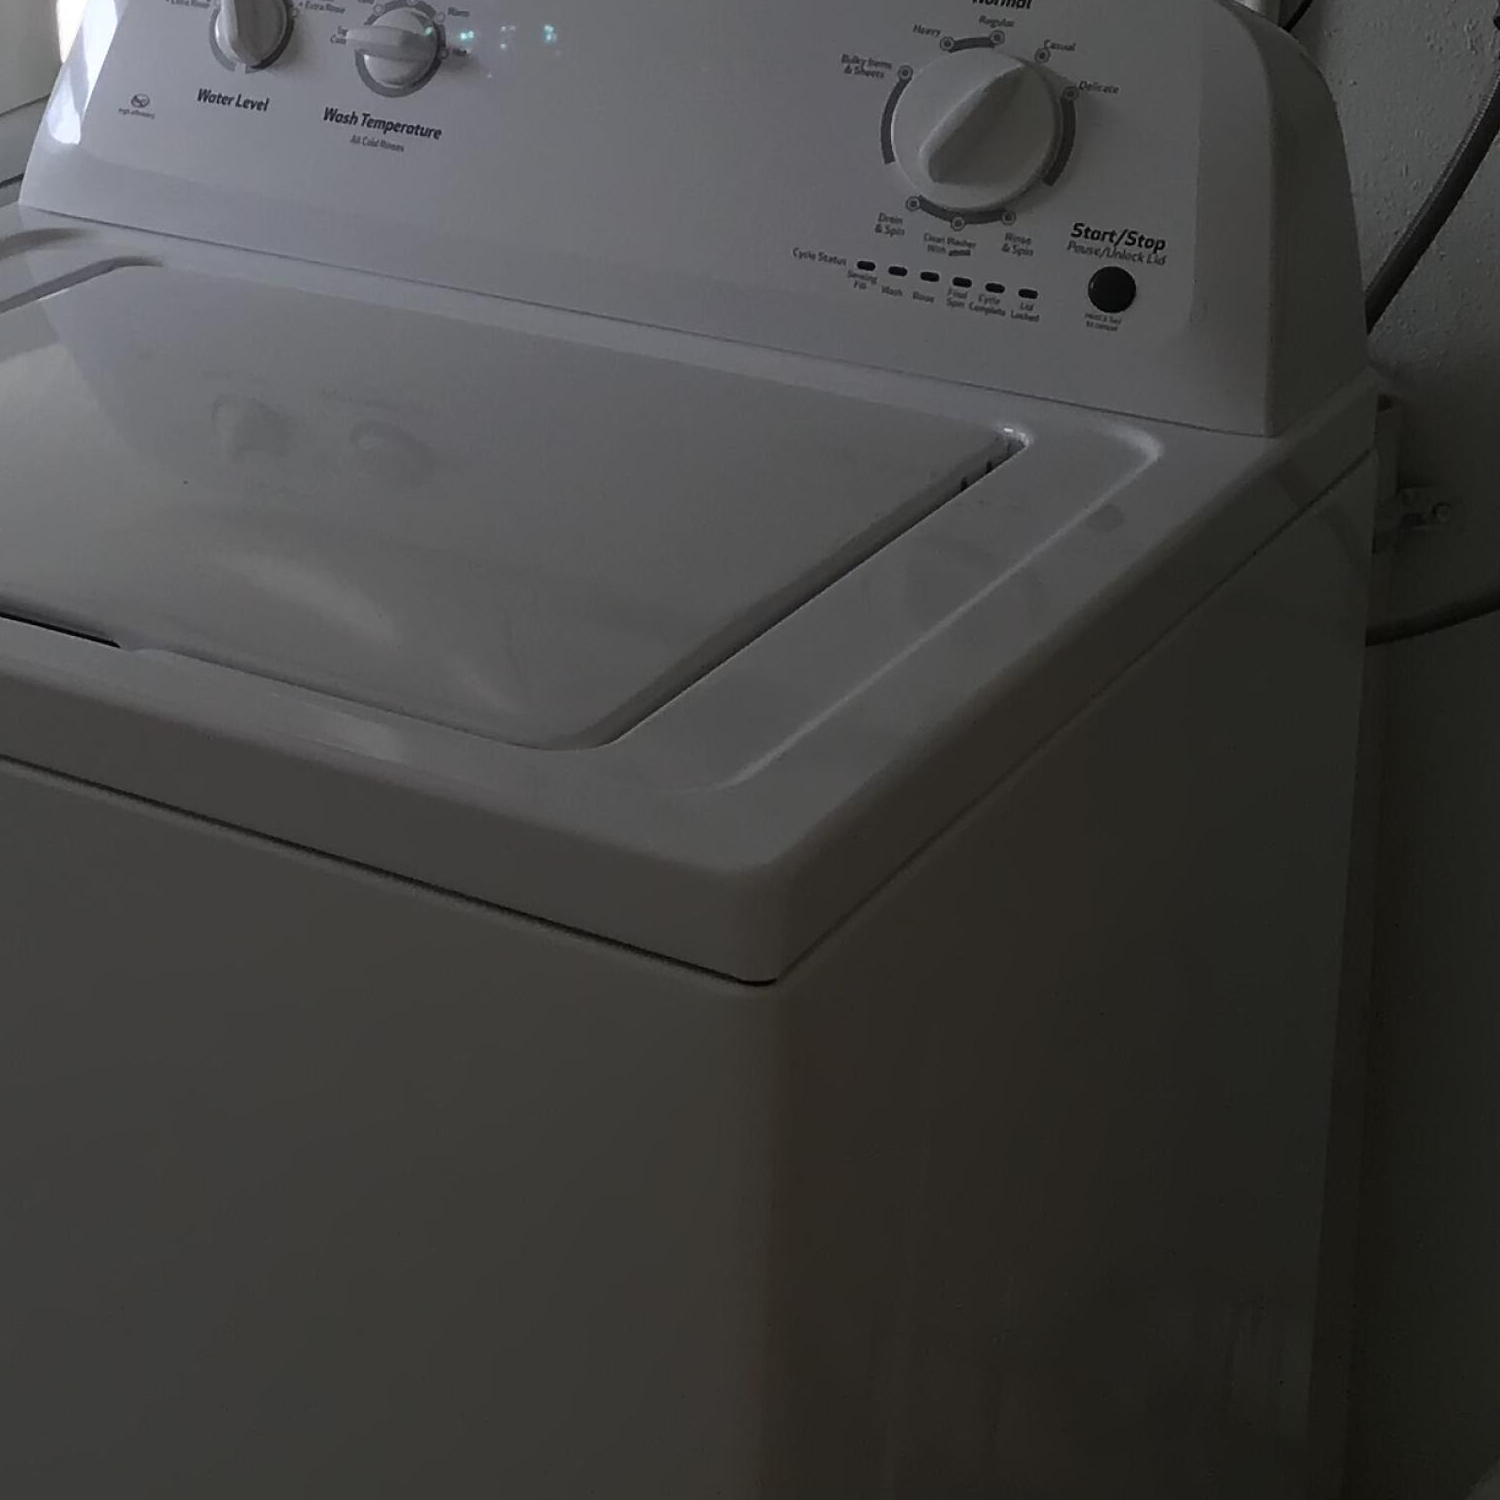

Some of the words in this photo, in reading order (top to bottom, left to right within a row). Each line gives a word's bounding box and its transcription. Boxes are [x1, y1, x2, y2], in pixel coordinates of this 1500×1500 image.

[978, 15, 1015, 29] Regular
[913, 23, 941, 38] Heavy
[1044, 39, 1076, 52] Casual
[841, 53, 866, 69] Bulky
[855, 66, 884, 79] Sheets
[1079, 80, 1120, 94] Delicate
[197, 88, 235, 106] Water
[235, 93, 270, 112] Level
[323, 106, 359, 126] Wash
[362, 112, 442, 140] Temperature
[878, 212, 903, 225] Drain
[874, 223, 883, 234] &
[884, 225, 905, 238] Spin
[1070, 221, 1166, 255] Start/Stop
[923, 232, 946, 243] Clean
[947, 237, 977, 250] Washer
[1005, 232, 1033, 246] Rinse
[792, 247, 817, 261] Cycle
[818, 251, 847, 266] Status
[1001, 243, 1011, 252] &
[1012, 244, 1034, 257] Spin
[1067, 240, 1144, 264] Pause/Unlock
[1146, 252, 1168, 266] Lid
[969, 301, 1006, 317] Complete
